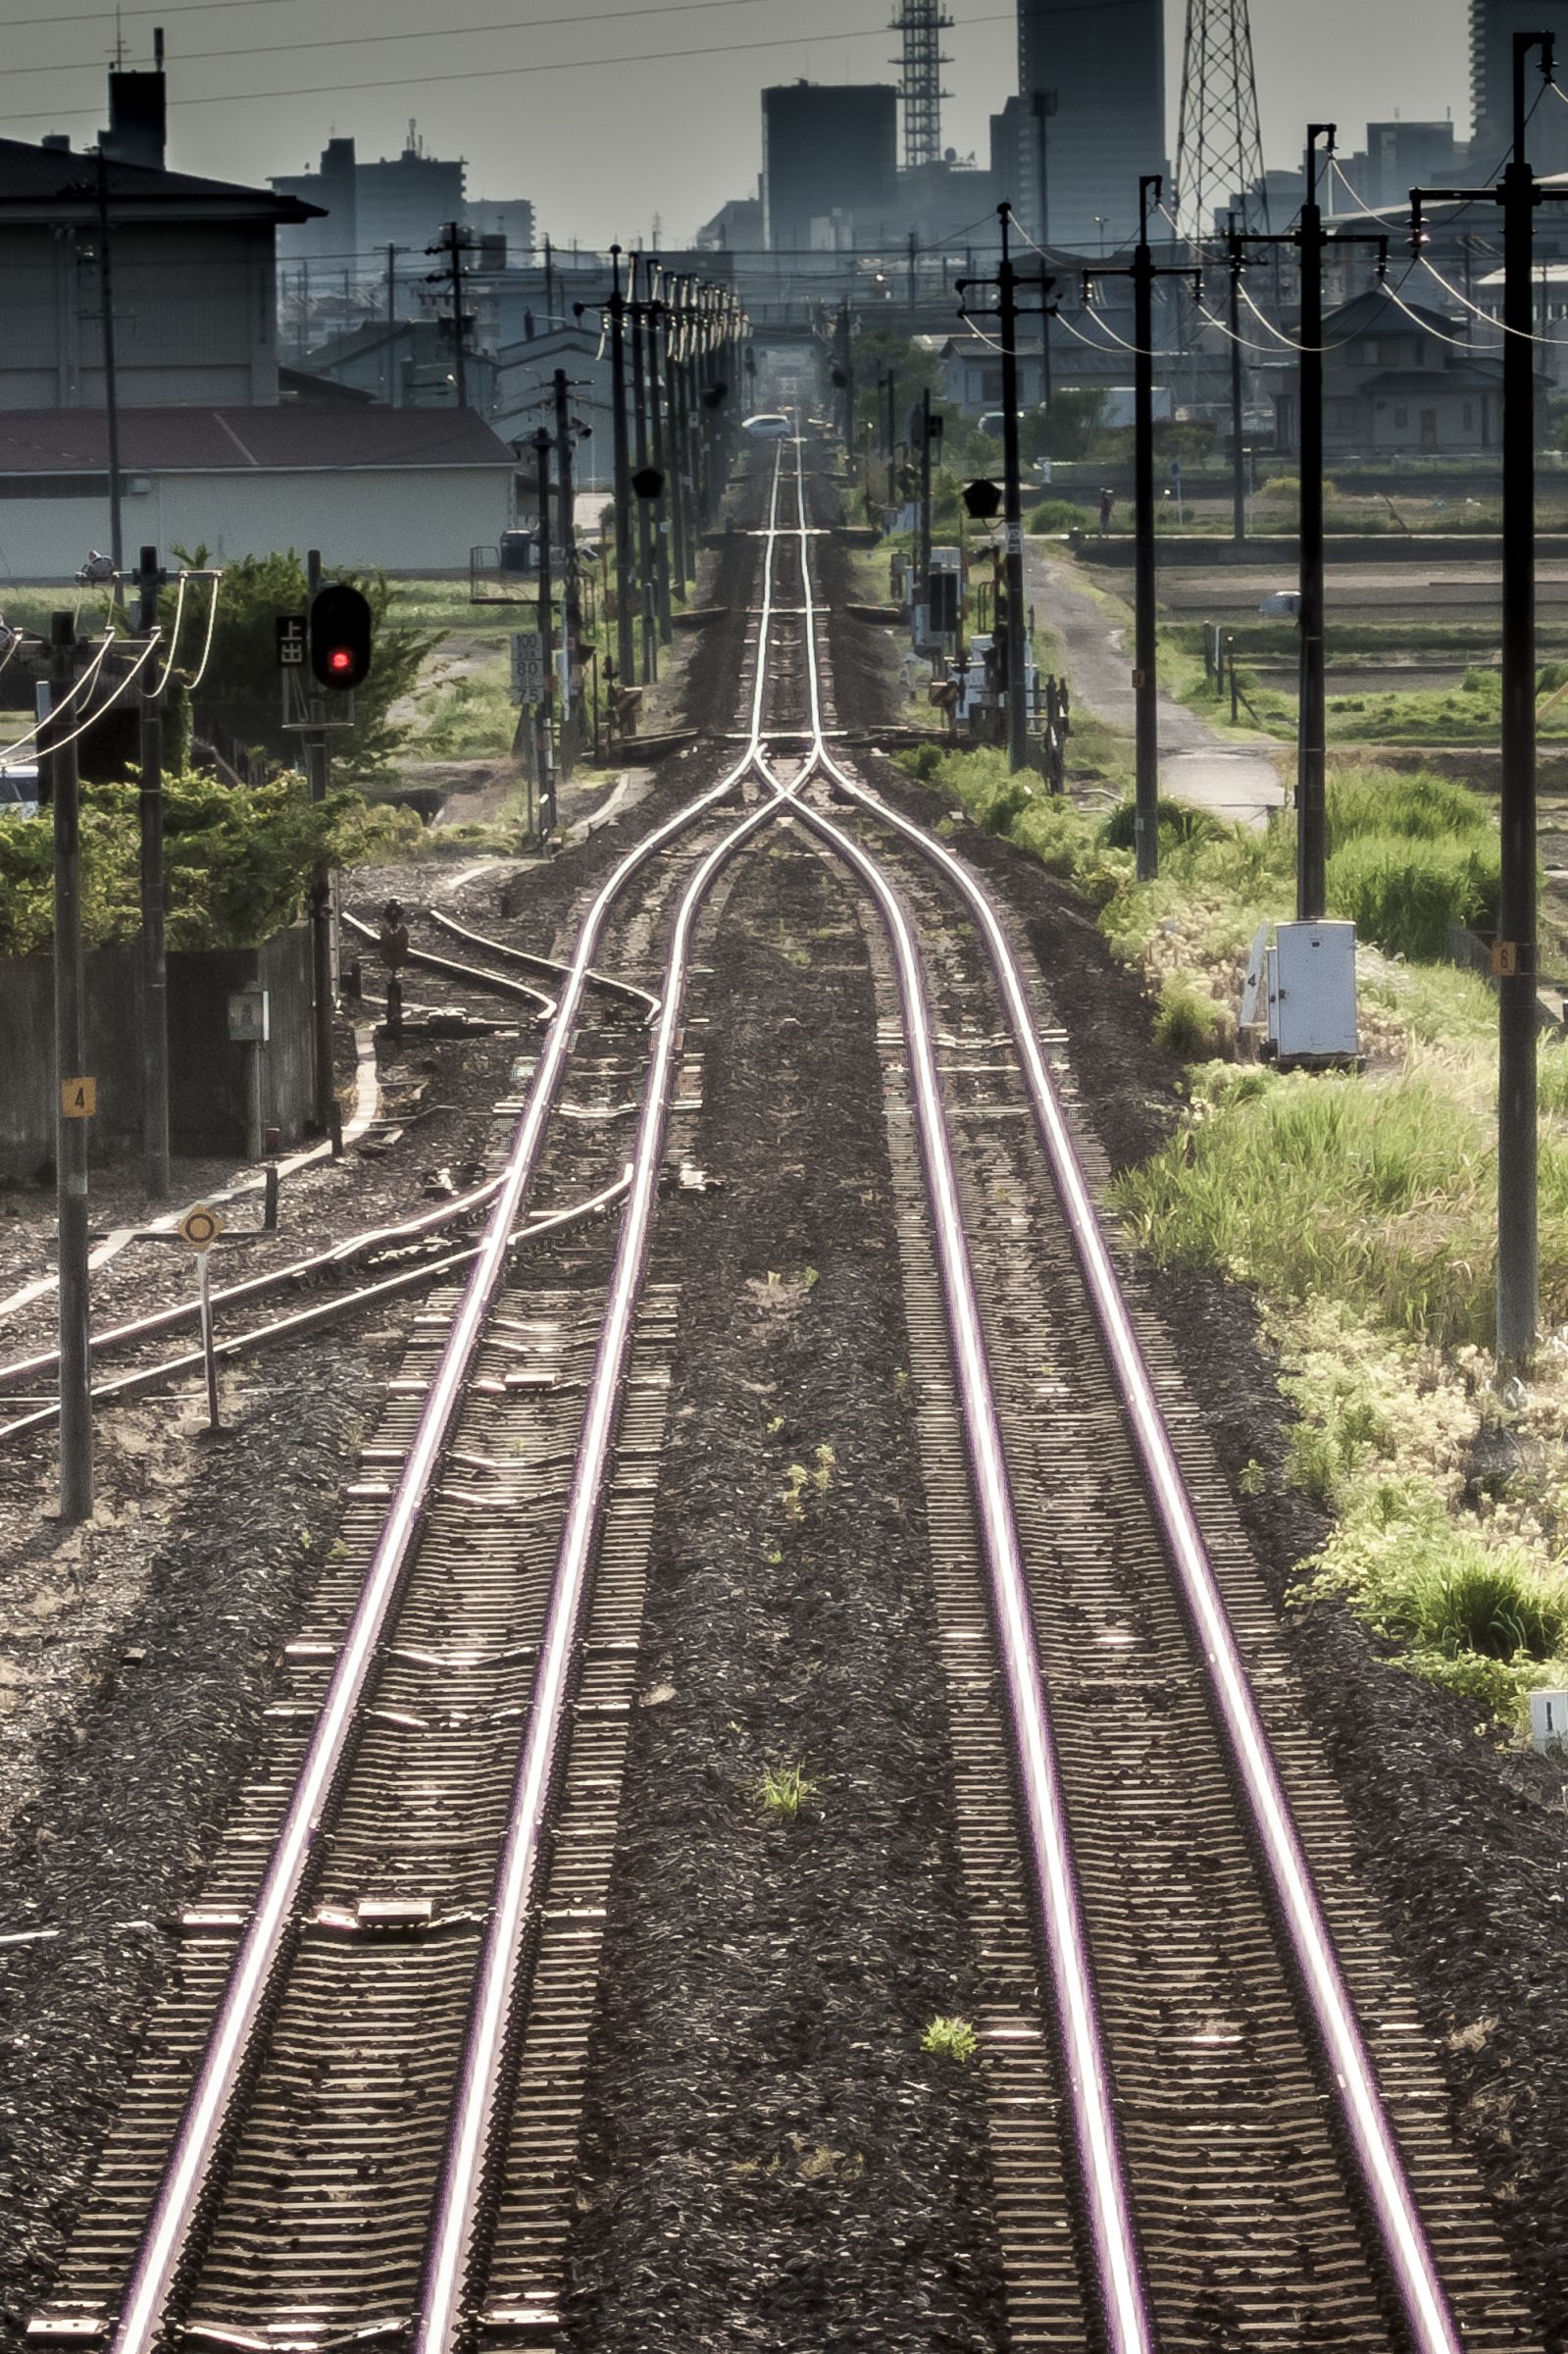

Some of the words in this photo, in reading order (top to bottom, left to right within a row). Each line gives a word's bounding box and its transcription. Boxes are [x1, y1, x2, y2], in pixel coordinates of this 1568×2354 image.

[280, 620, 302, 662] 上出
[517, 661, 537, 676] 80
[1500, 948, 1508, 968] 6
[75, 1088, 85, 1108] 4
